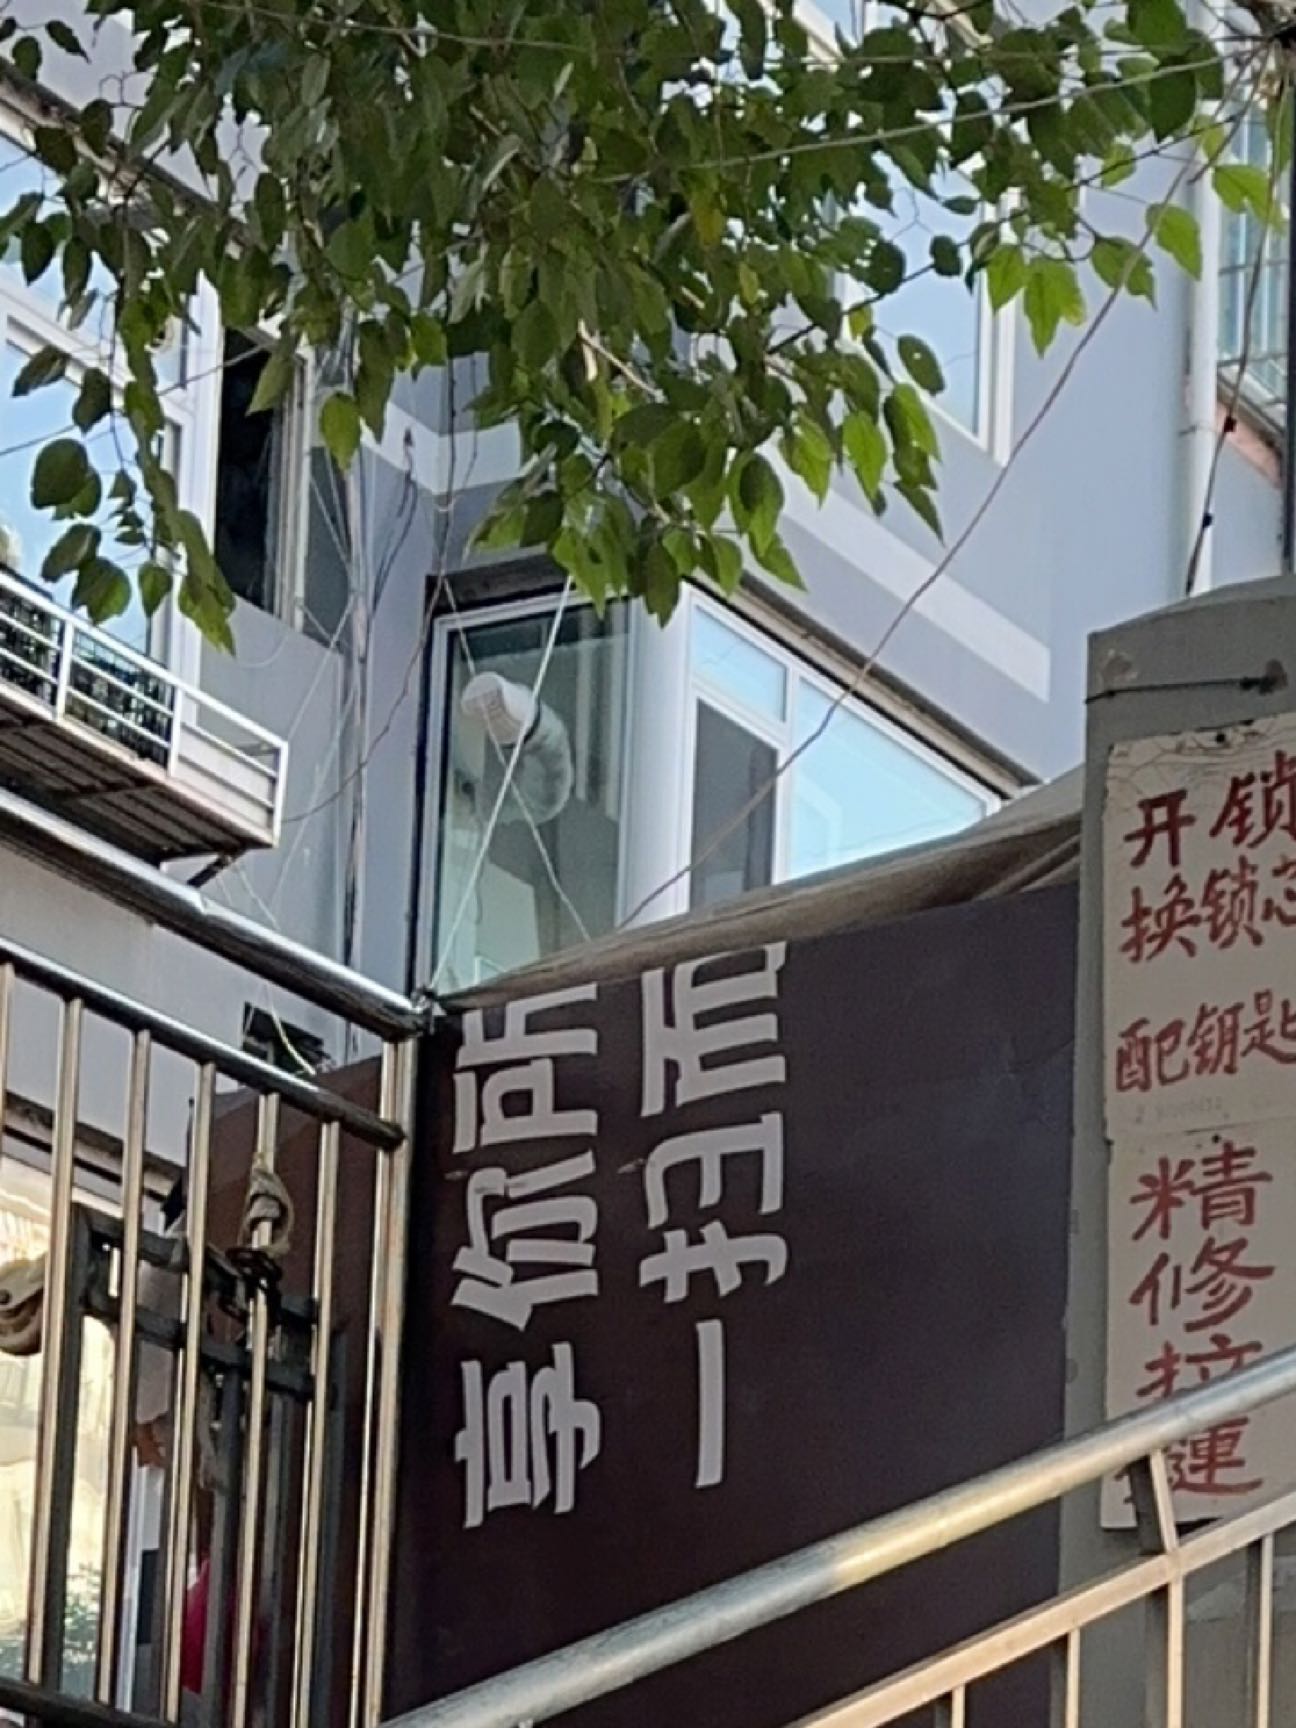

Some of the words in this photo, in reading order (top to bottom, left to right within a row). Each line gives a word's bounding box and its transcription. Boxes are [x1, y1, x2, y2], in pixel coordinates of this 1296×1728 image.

[451, 981, 600, 1529] 享你所
[639, 940, 788, 1489] 一扫而
